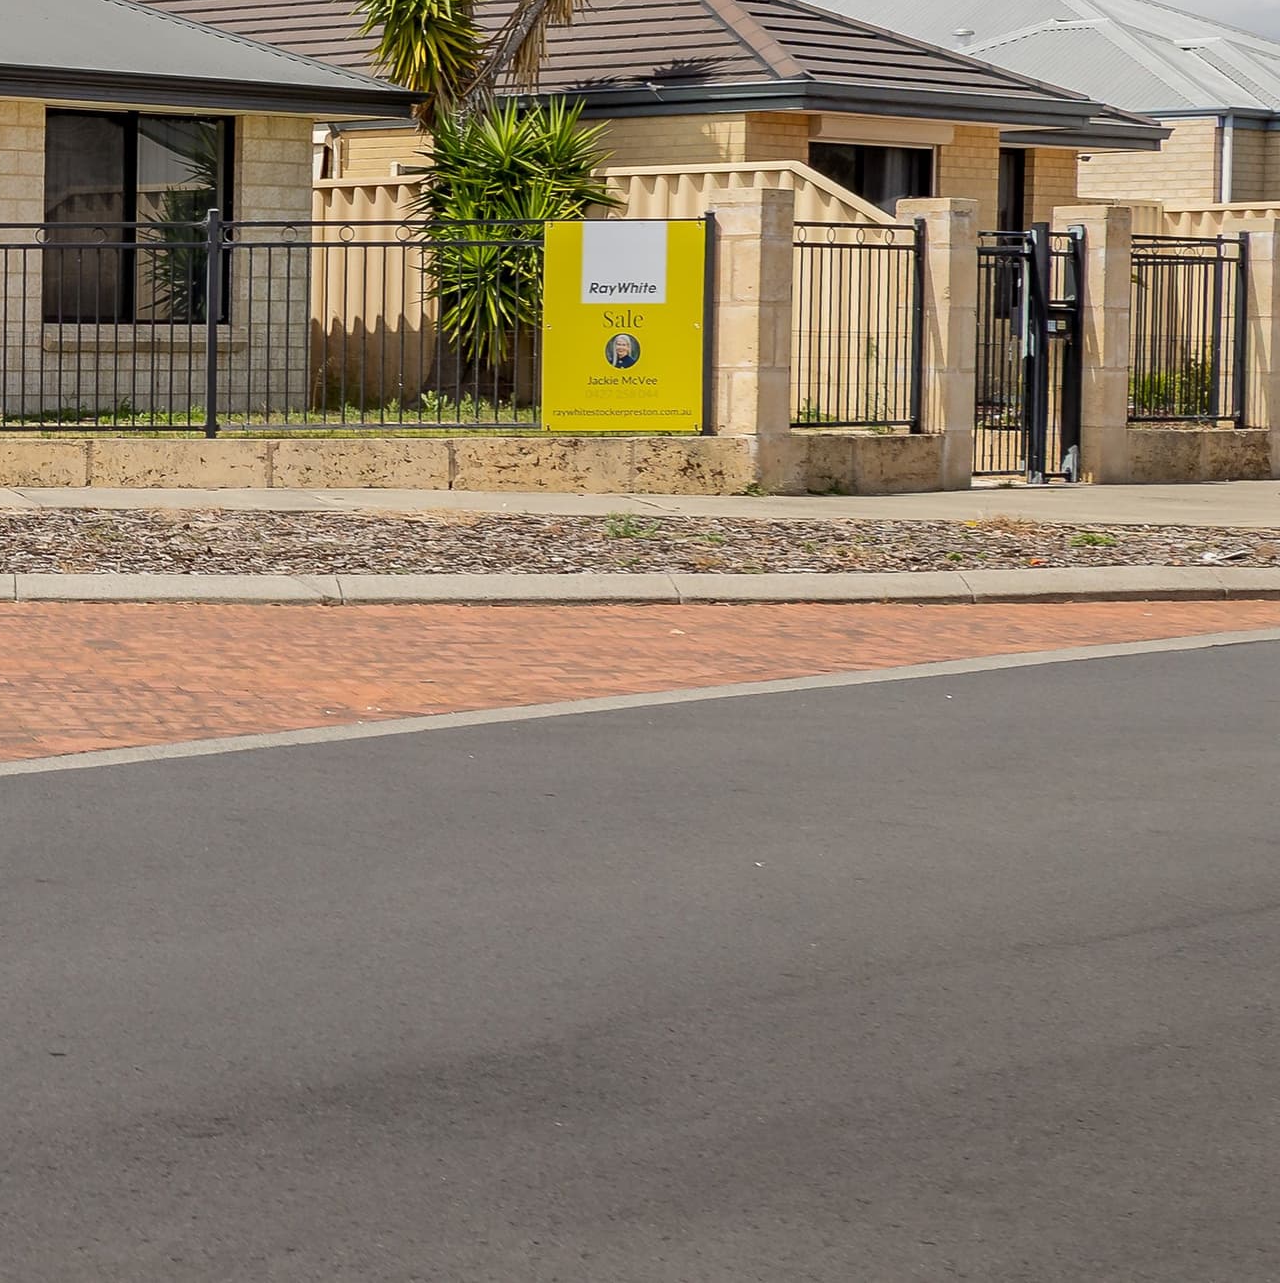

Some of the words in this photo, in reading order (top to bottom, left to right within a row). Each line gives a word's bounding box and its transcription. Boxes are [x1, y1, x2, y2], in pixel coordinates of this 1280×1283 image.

[602, 309, 644, 329] Sale
[587, 376, 619, 386] Jackie
[621, 376, 658, 386] McVee
[552, 407, 692, 417] raywhitestockerpreston.com.au
